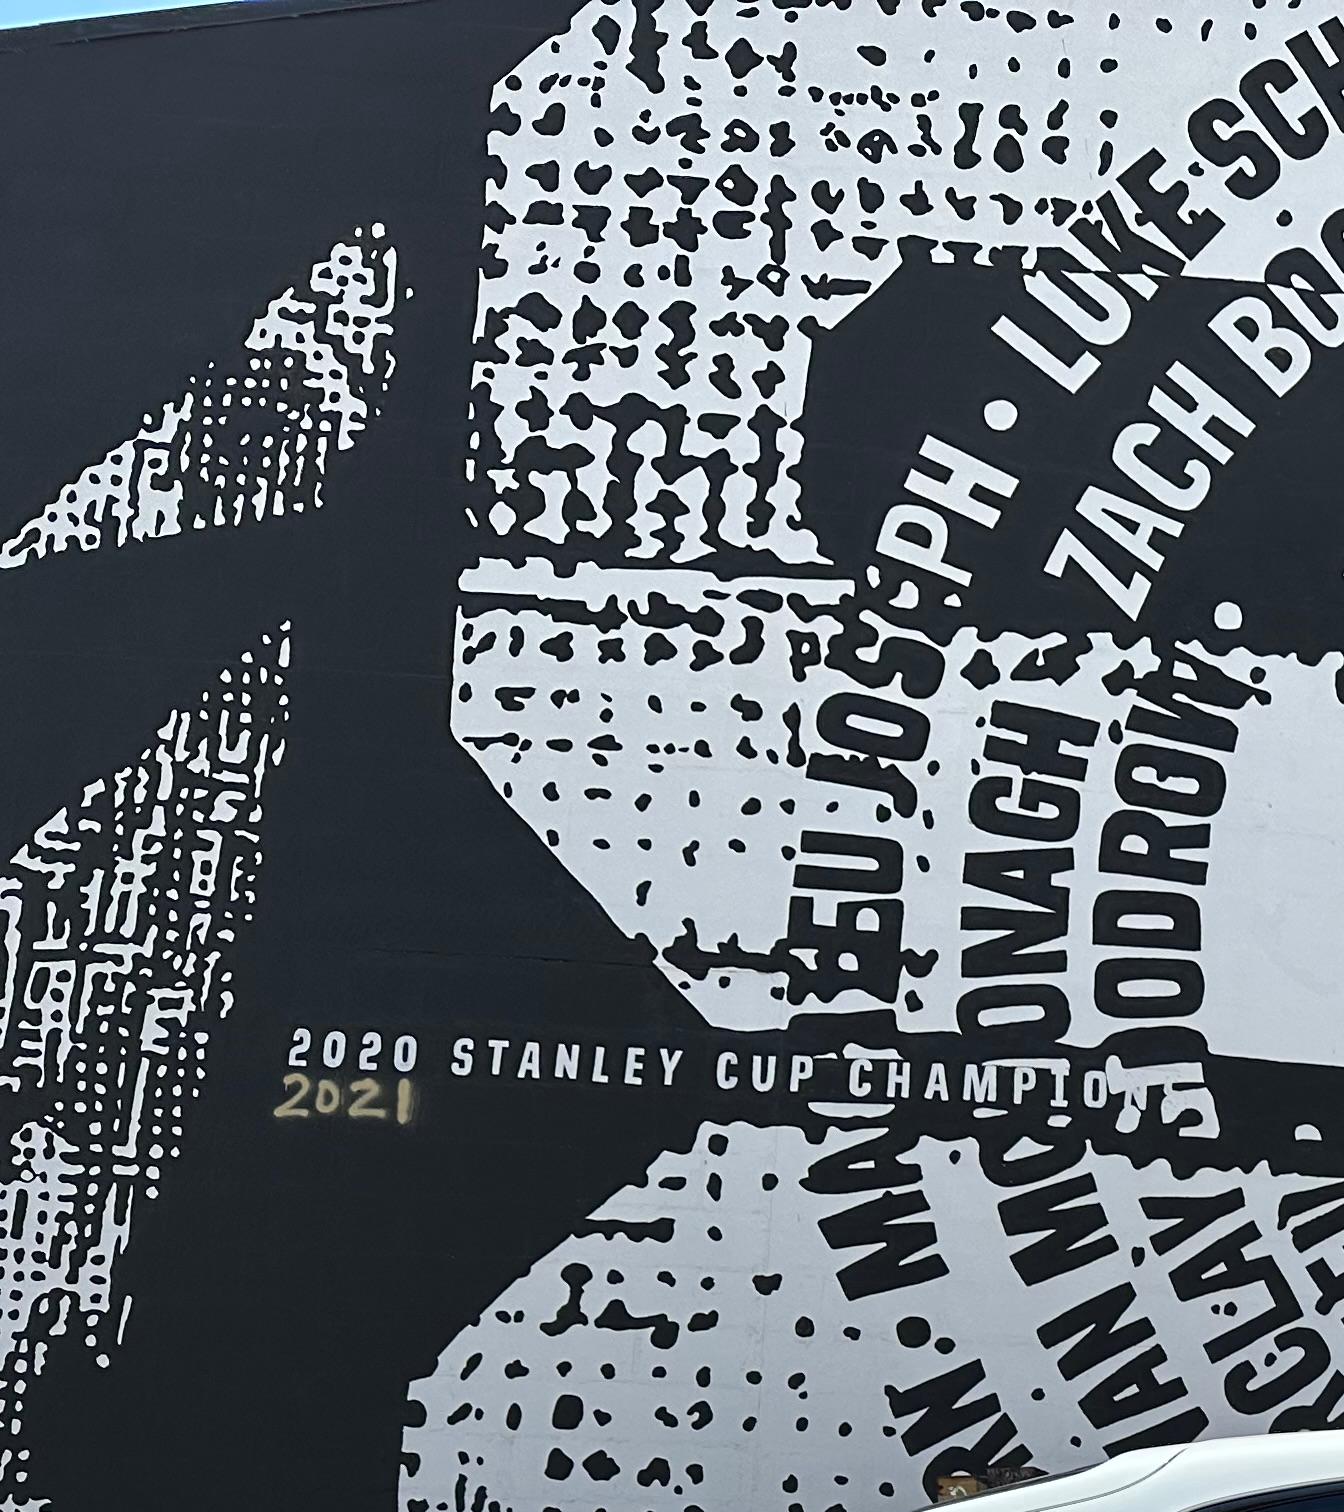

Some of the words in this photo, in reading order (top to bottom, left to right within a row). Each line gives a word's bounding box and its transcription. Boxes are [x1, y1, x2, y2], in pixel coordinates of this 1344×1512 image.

[990, 148, 1226, 394] LUKE
[1043, 360, 1256, 622] ZACH
[805, 433, 1020, 817] JOSPH
[273, 1072, 413, 1125] 2021
[288, 1027, 418, 1073] 2020
[450, 1037, 684, 1086] STANLEY
[715, 1050, 814, 1093] CUP
[847, 1056, 1150, 1112] CHAMPION
